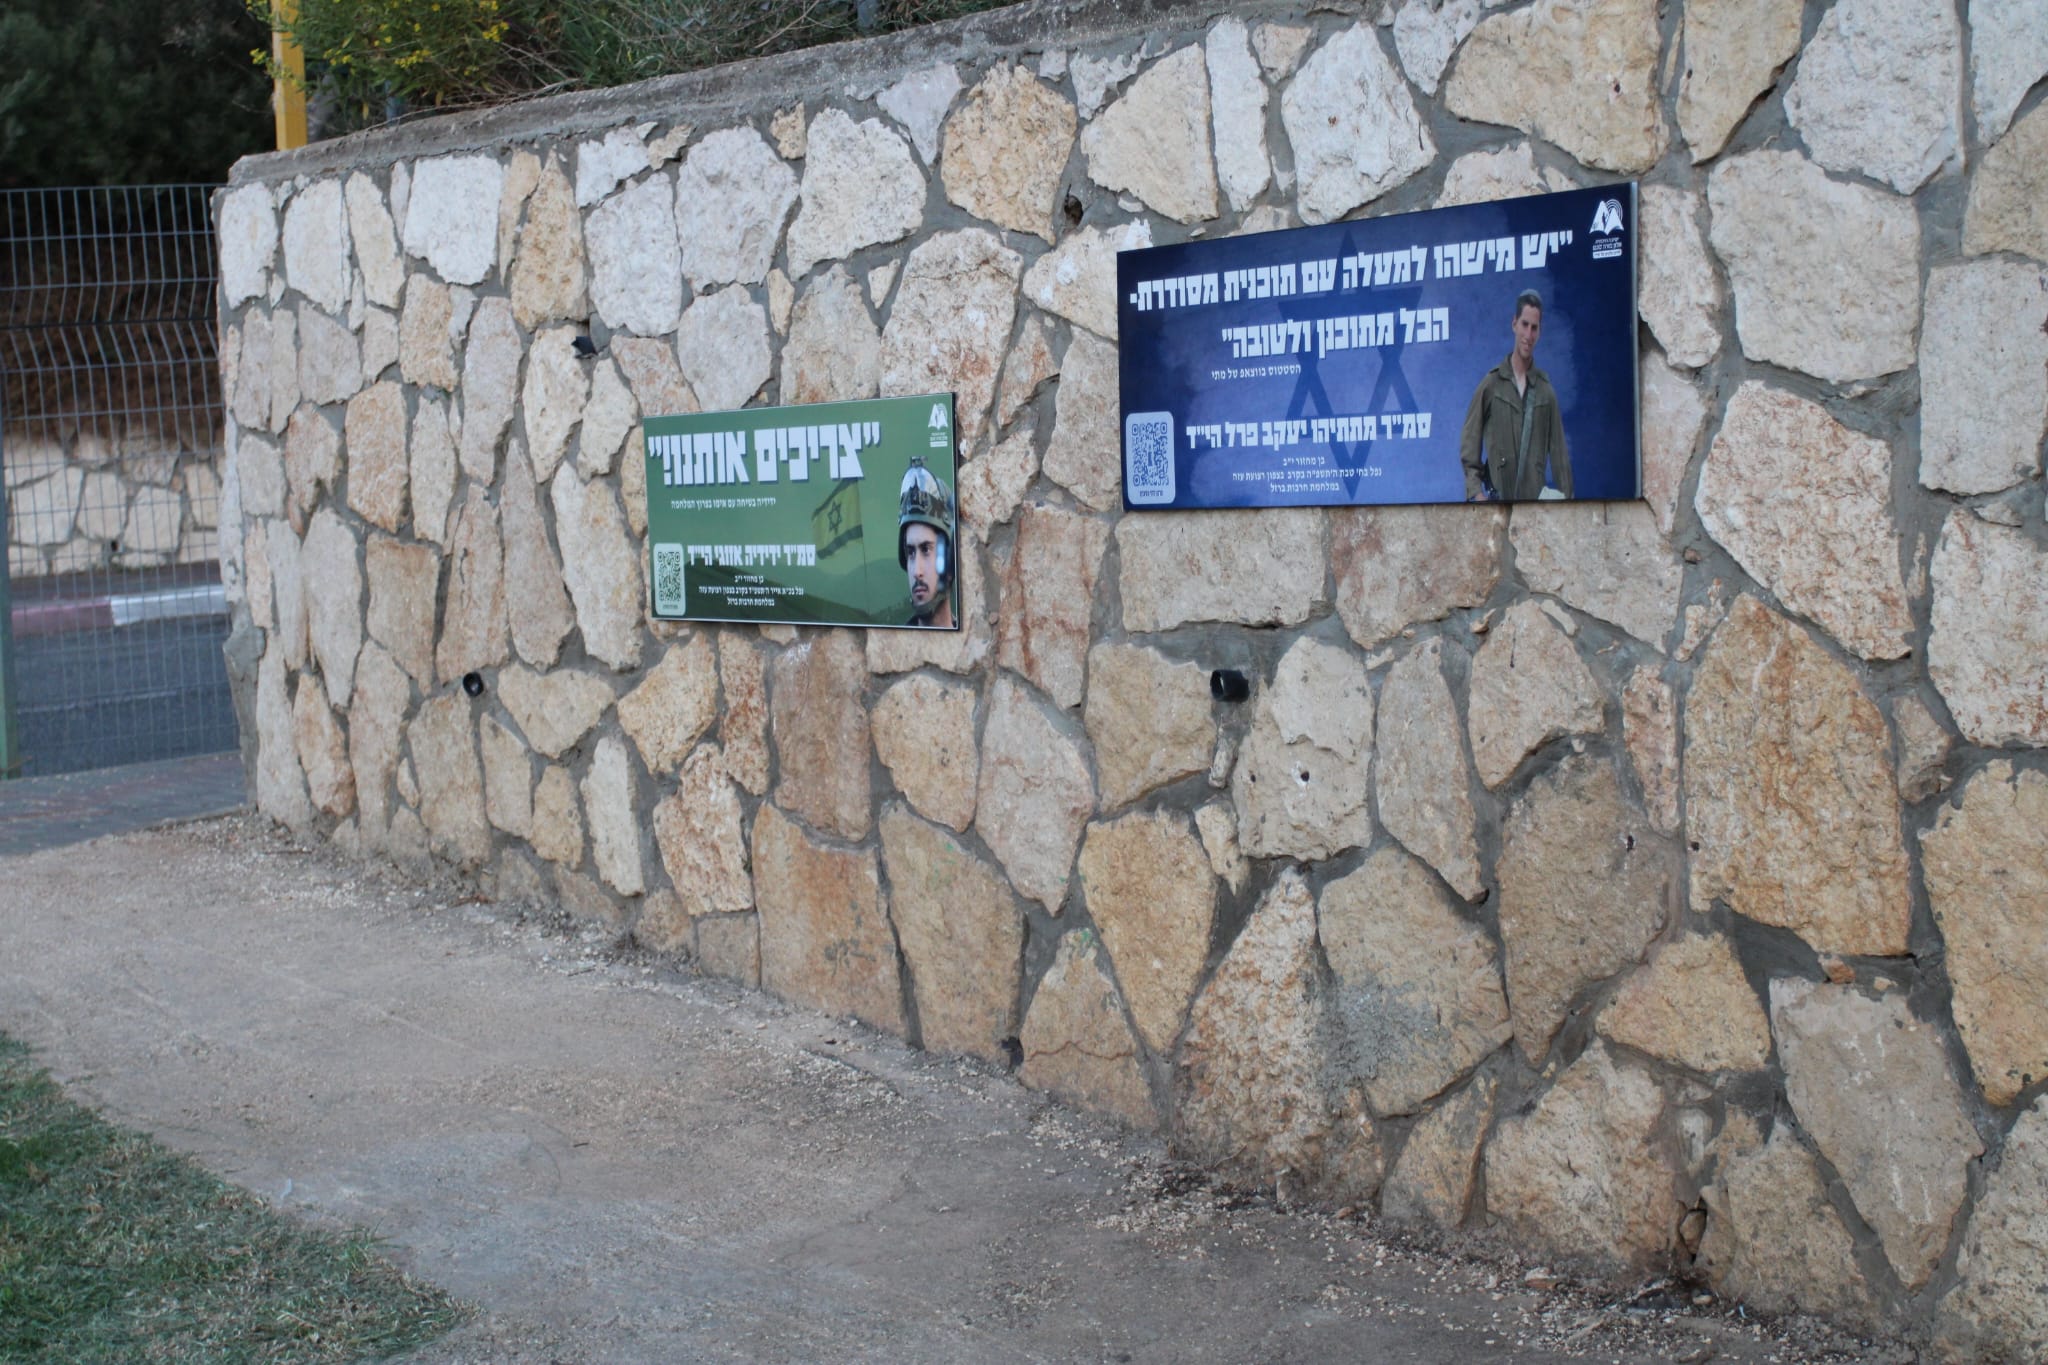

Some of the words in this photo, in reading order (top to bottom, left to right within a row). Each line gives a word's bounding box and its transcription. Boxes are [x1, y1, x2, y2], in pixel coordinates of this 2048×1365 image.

[1342, 244, 1428, 290] למעלה
[1433, 236, 1516, 280] מישהו
[1224, 263, 1297, 303] תוכנית
[1301, 258, 1338, 294] עם
[1316, 312, 1394, 359] מתוכנן
[1400, 307, 1449, 344] הכל
[1211, 370, 1226, 381] מתי
[1227, 367, 1239, 379] של
[1267, 364, 1302, 377] הסטטוס
[1224, 421, 1259, 447] פרל
[1262, 419, 1308, 451] יעקב
[1311, 416, 1378, 443] מתתיהו
[1295, 457, 1317, 466] מחזור
[1317, 456, 1326, 467] בן
[1369, 465, 1382, 476] נפל
[744, 544, 781, 566] ידידיה
